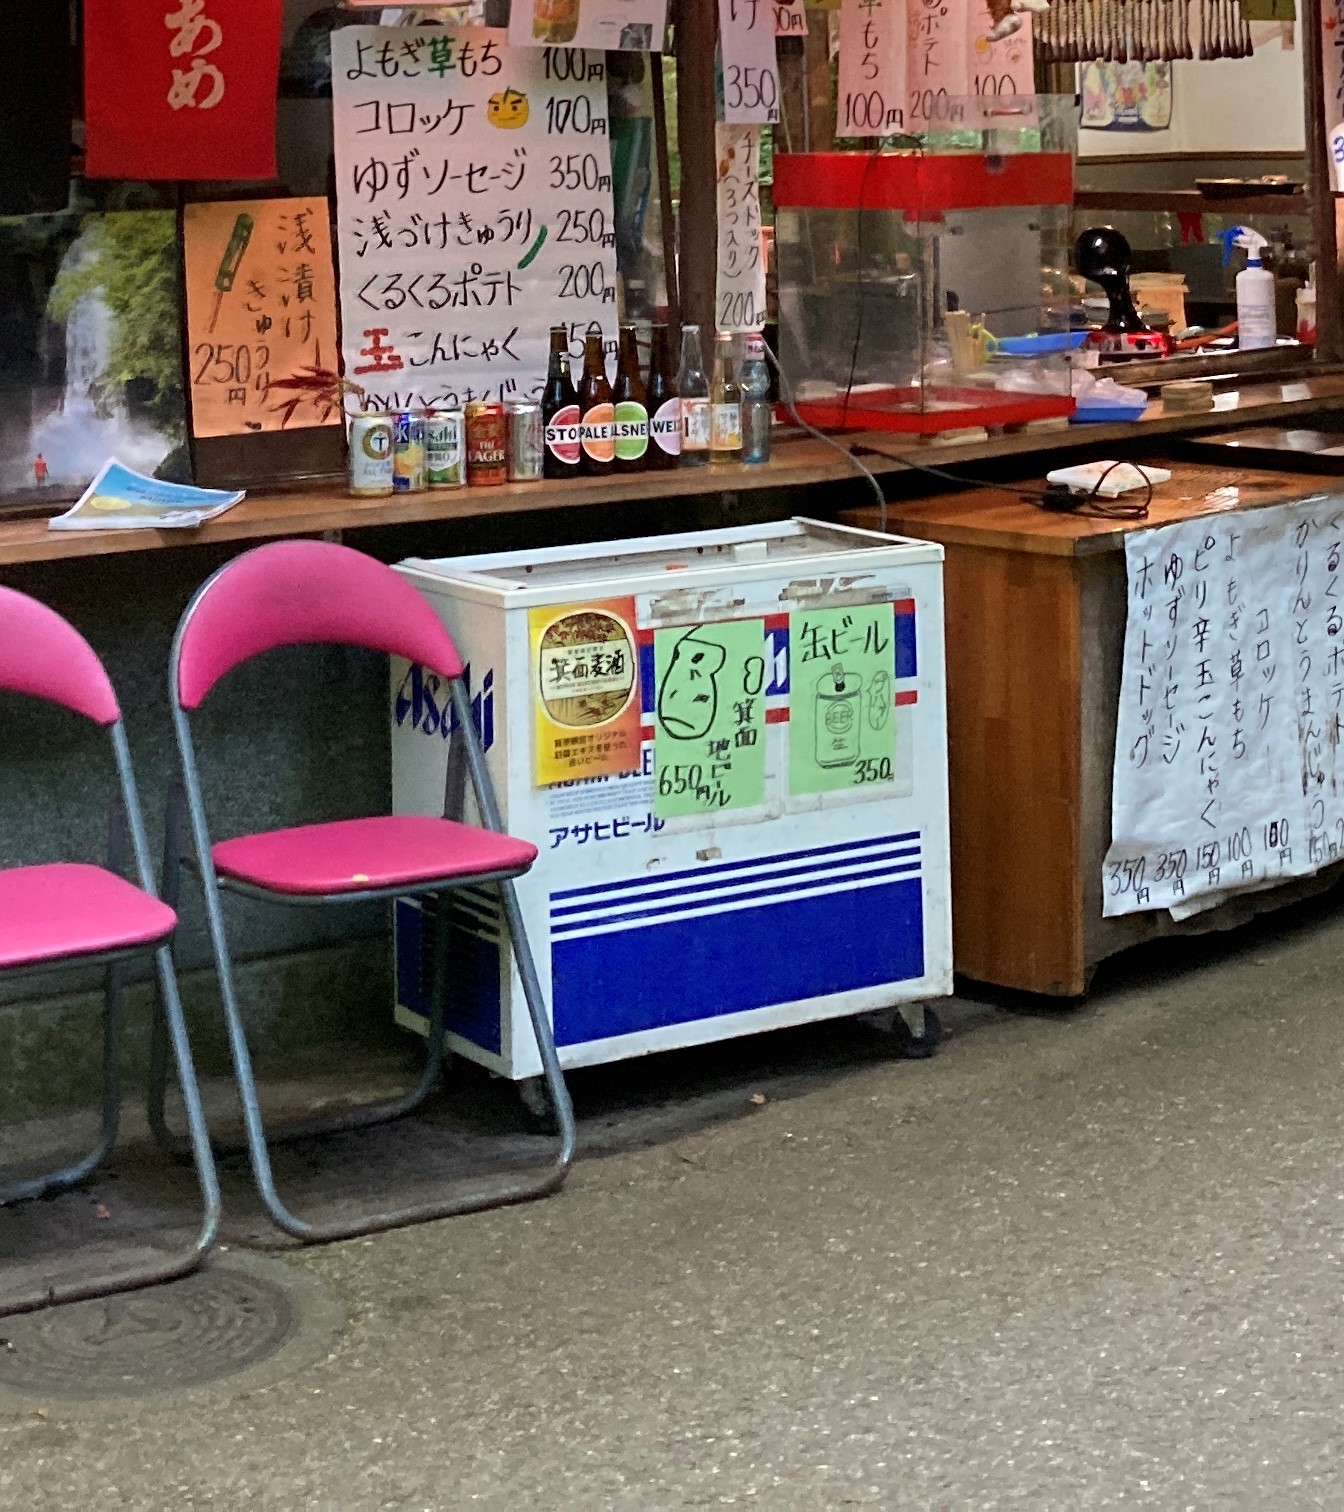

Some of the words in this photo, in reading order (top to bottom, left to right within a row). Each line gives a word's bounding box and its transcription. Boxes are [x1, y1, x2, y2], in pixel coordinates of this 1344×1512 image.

[346, 38, 504, 79] よもぎ草もち
[542, 48, 606, 82] 100円
[727, 64, 779, 122] 350円
[844, 90, 905, 131] 100円
[354, 99, 475, 136] コロッケ
[353, 146, 528, 202] ゆずソーセージ
[549, 153, 612, 192] 350円
[353, 207, 534, 257] 浅づけきゅうり
[556, 206, 616, 249] 250円
[276, 207, 317, 344] 浅漬け
[356, 263, 523, 311] くるくるポテト
[557, 261, 617, 303] 200円
[798, 615, 891, 663] 缶ビール
[1129, 555, 1155, 769] ホットドッグ
[1162, 553, 1186, 764] ゆずソーセージ
[1225, 533, 1247, 760] よもぎ草もち
[548, 648, 626, 683] 箕面麦酒
[1256, 608, 1276, 730] コロッケ
[548, 812, 666, 849] アサヒビール
